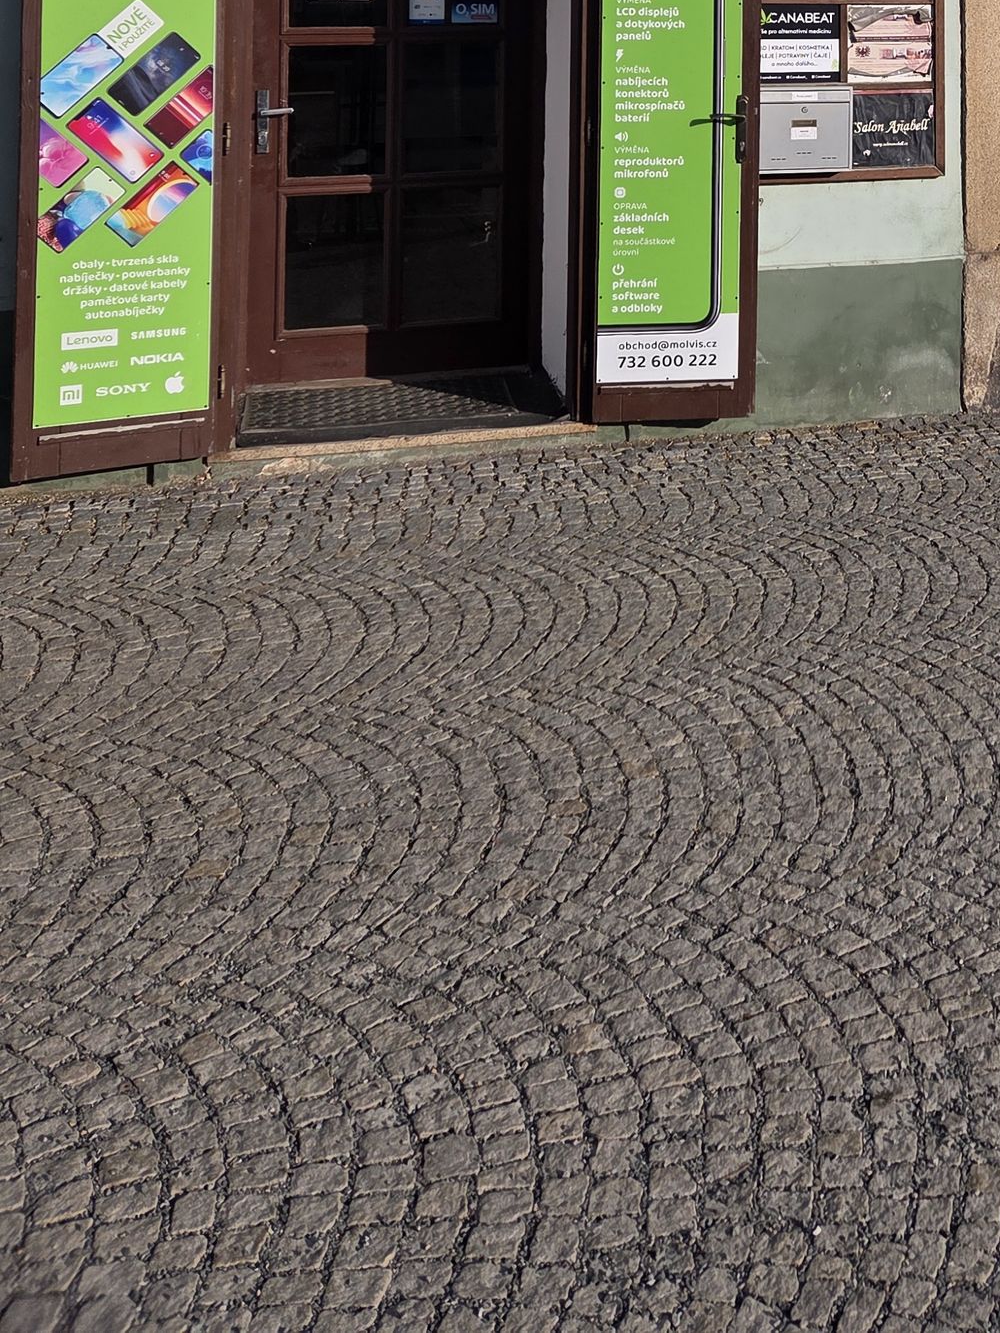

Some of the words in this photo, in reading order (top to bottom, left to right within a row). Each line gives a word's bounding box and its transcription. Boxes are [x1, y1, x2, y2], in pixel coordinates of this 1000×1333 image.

[471, 3, 494, 14] SIM
[616, 7, 636, 17] LCD
[638, 7, 679, 19] displejů
[770, 12, 835, 23] CANABEAT
[107, 6, 147, 44] NOVÉ
[625, 19, 685, 30] dotykových
[616, 31, 651, 42] panelů
[615, 65, 650, 74] VÝMĚNA
[615, 76, 668, 88] nabíjecích
[615, 88, 669, 98] konektorů
[615, 100, 685, 111] mikrospínačů
[615, 113, 650, 122] baterií
[854, 120, 884, 133] Salon
[614, 145, 649, 154] VÝMĚNA
[614, 156, 684, 168] reproduktorů
[614, 168, 669, 178] mikrofonů
[613, 213, 669, 222] základních
[613, 225, 645, 235] desek
[625, 237, 676, 246] součástkové
[72, 259, 104, 271] obaly
[112, 256, 154, 267] tvrzená
[156, 254, 179, 264] skla
[60, 271, 114, 283] nabíječky
[122, 266, 190, 280] powerbanky
[62, 284, 102, 296] držáky
[109, 281, 148, 292] datové
[150, 279, 187, 290] kabely
[612, 278, 657, 290] přehrání
[80, 295, 138, 309] paměťové
[140, 293, 170, 305] karty
[612, 291, 660, 301] software
[85, 305, 165, 319] autonabíječky
[621, 303, 662, 314] odbloky
[66, 333, 113, 346] Lenovo
[130, 327, 186, 340] SAMSUNG
[619, 339, 717, 351] obchod@molvis.cz
[80, 360, 118, 371] HUAWEI
[130, 352, 184, 365] NOKIA
[618, 356, 646, 368] 732
[651, 355, 683, 367] 600
[689, 354, 717, 366] 222
[96, 382, 151, 397] SONY
